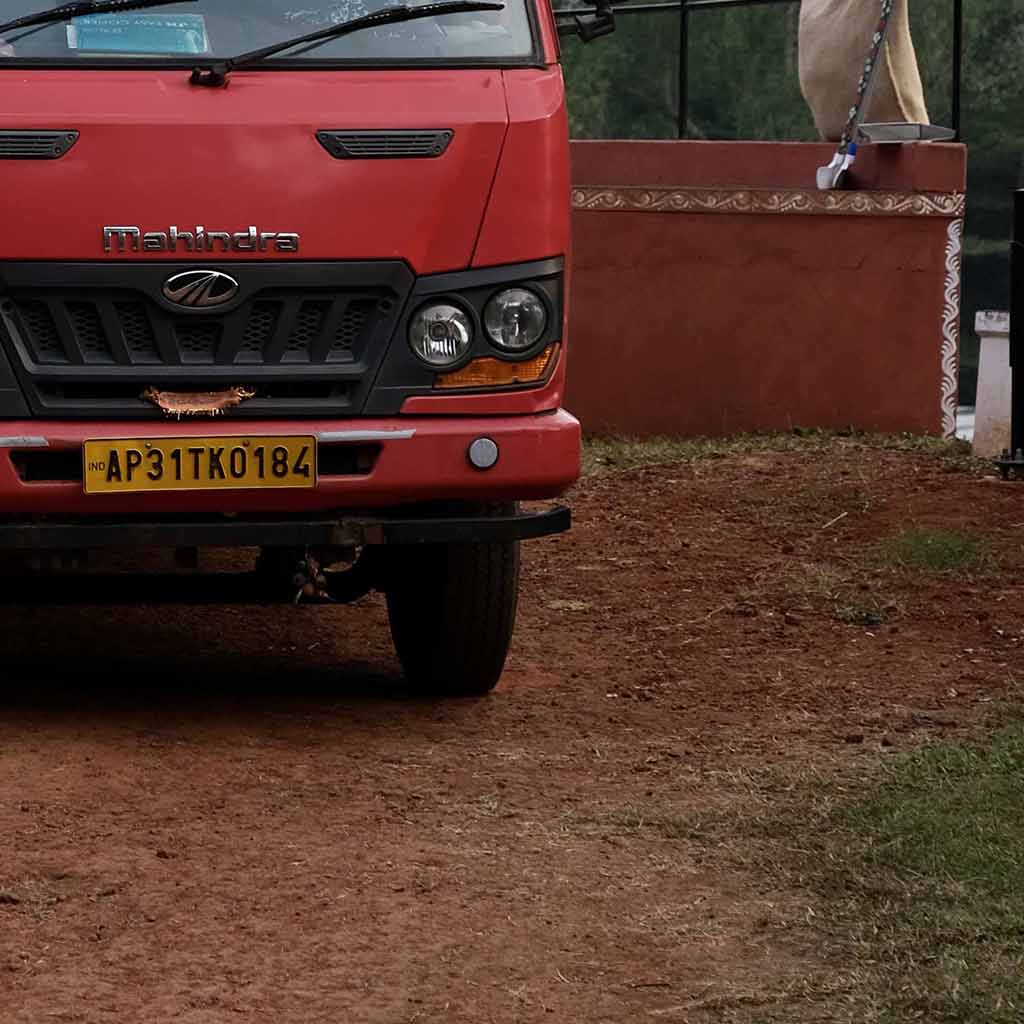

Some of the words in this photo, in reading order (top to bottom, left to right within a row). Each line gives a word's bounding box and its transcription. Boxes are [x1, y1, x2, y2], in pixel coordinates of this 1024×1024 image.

[103, 225, 301, 252] Mahindra
[88, 461, 106, 472] IND
[106, 446, 310, 482] AP31TK0184
